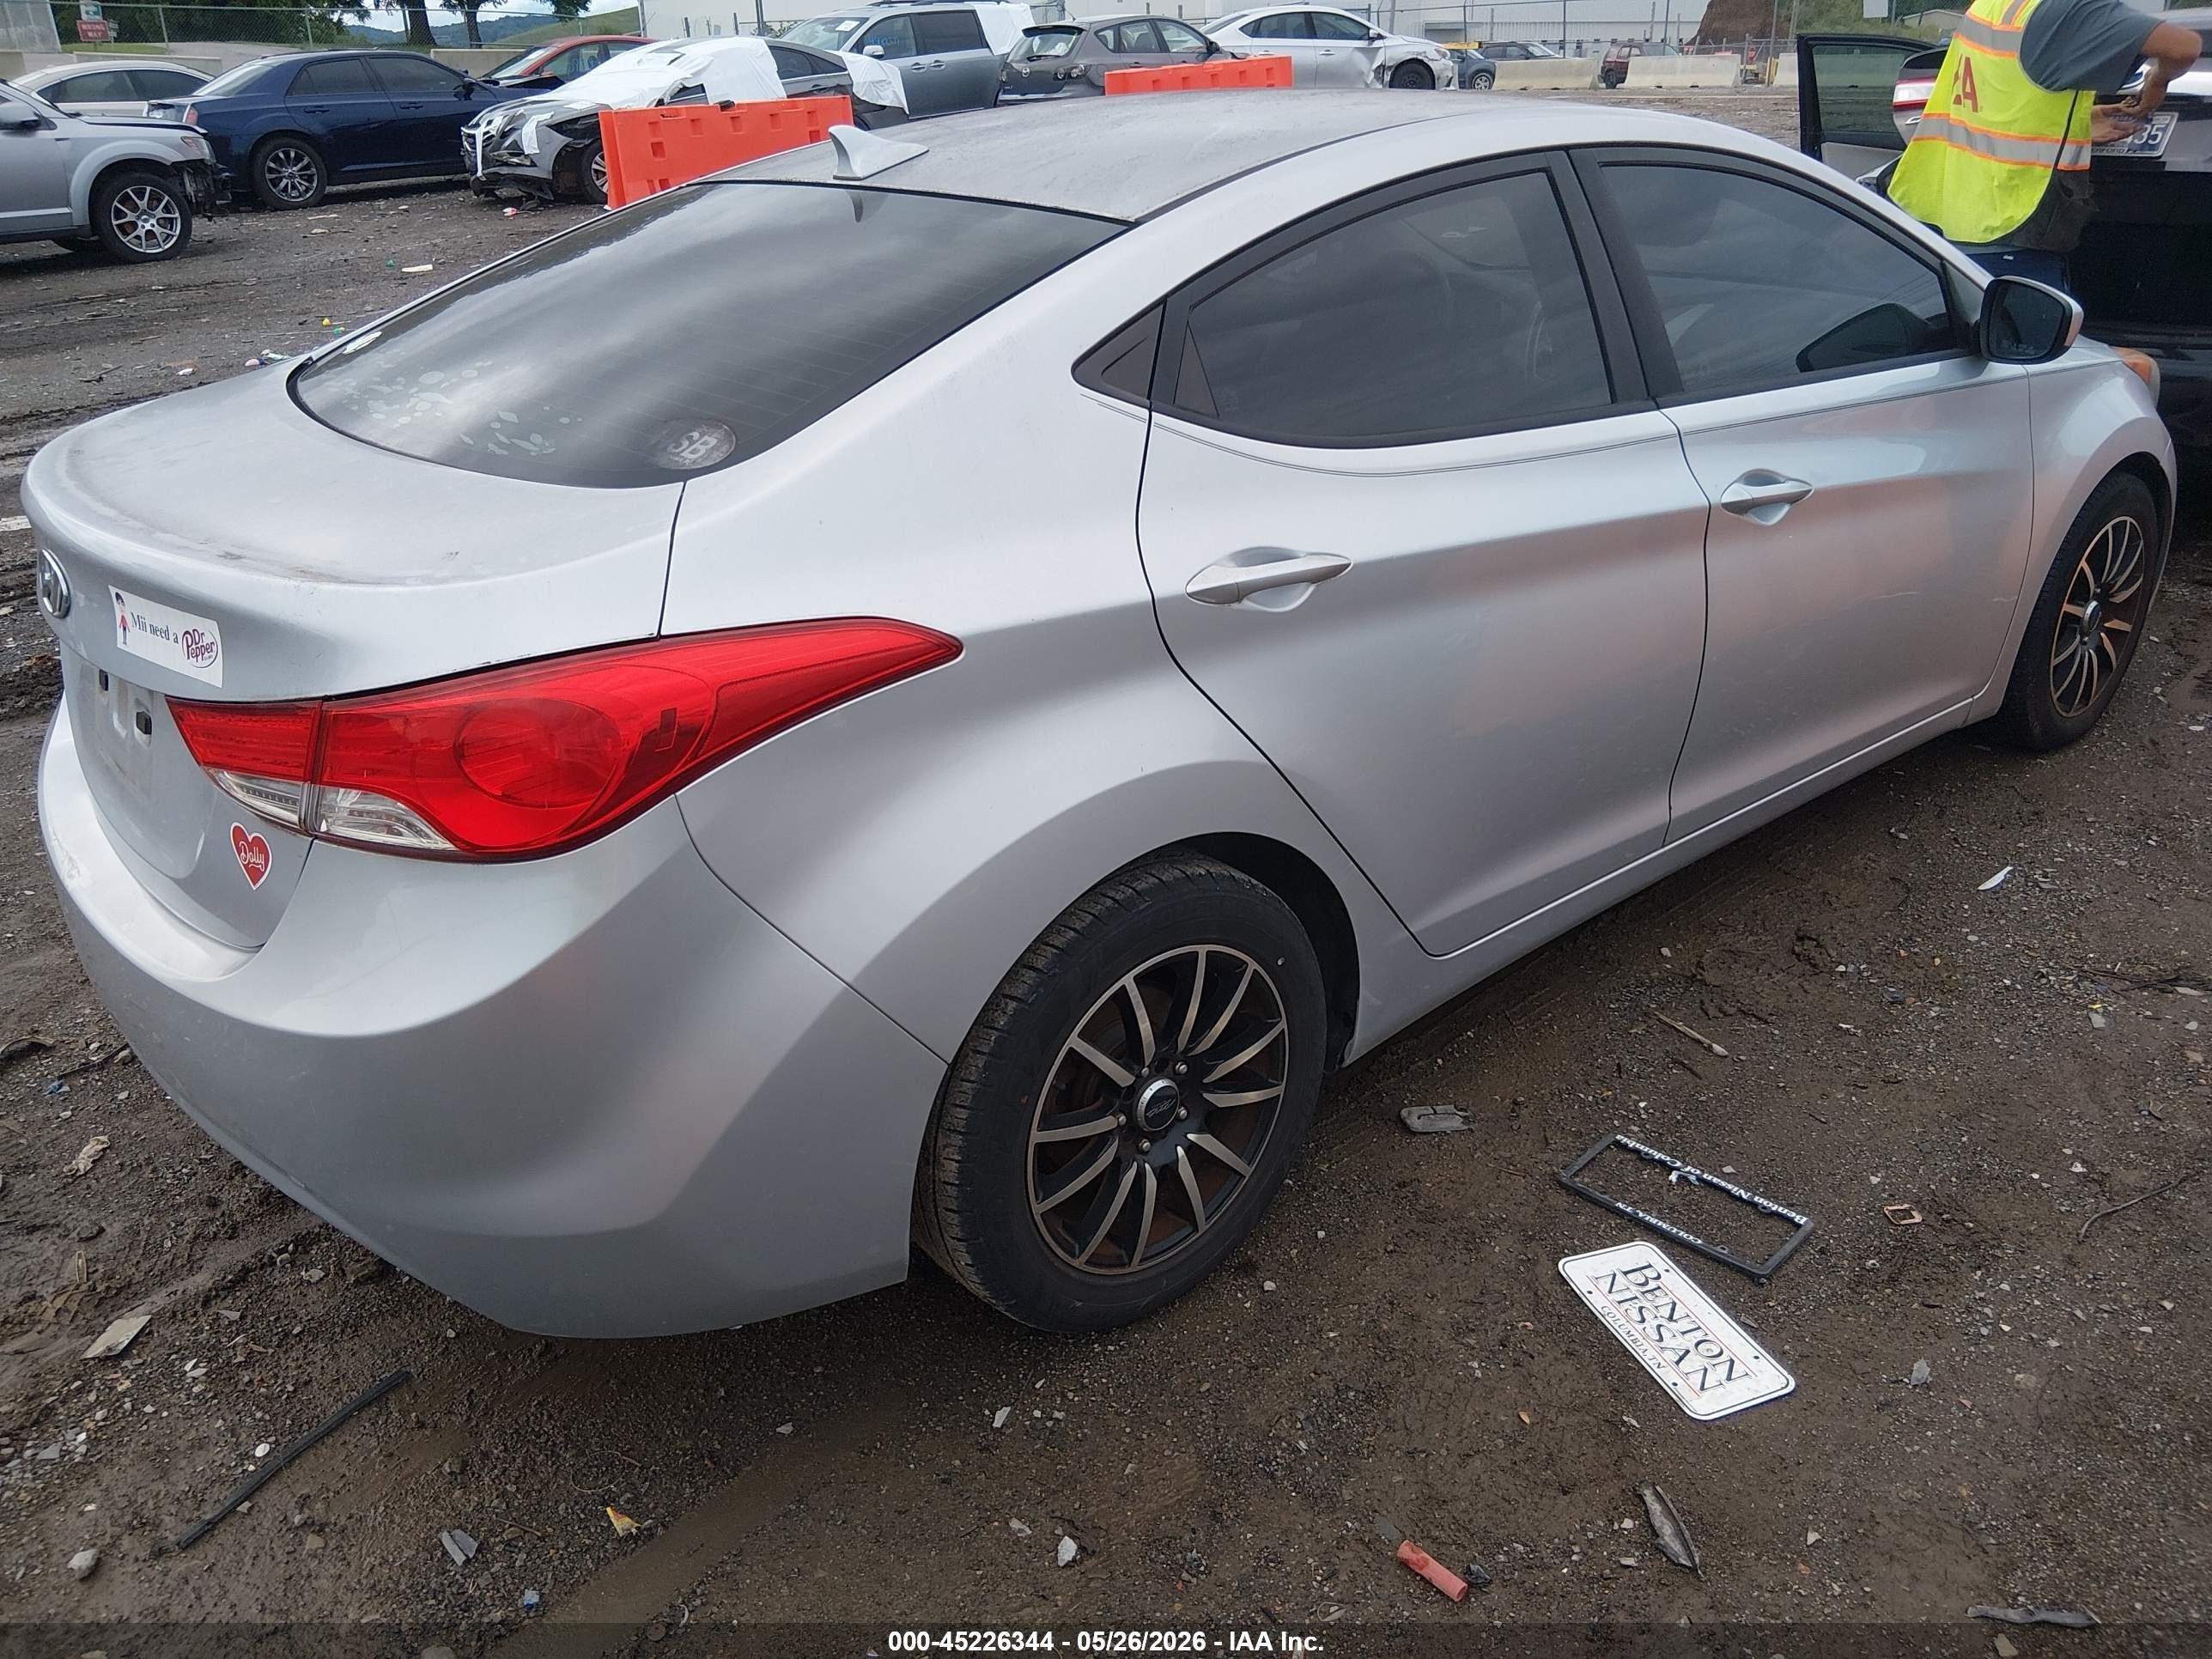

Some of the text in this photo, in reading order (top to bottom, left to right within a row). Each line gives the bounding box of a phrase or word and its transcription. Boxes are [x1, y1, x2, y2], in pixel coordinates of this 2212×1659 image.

[131, 611, 179, 644] Mii need a
[192, 629, 205, 646] Dr
[182, 630, 216, 663] Pepper
[239, 841, 265, 872] Dolly
[1615, 1134, 1808, 1225] Benton Nissan of Columbia
[1615, 1202, 1635, 1213] TN
[1592, 1271, 1727, 1391] NISSAN
[1617, 1262, 1752, 1382] BENTON
[1648, 1355, 1668, 1369] TN
